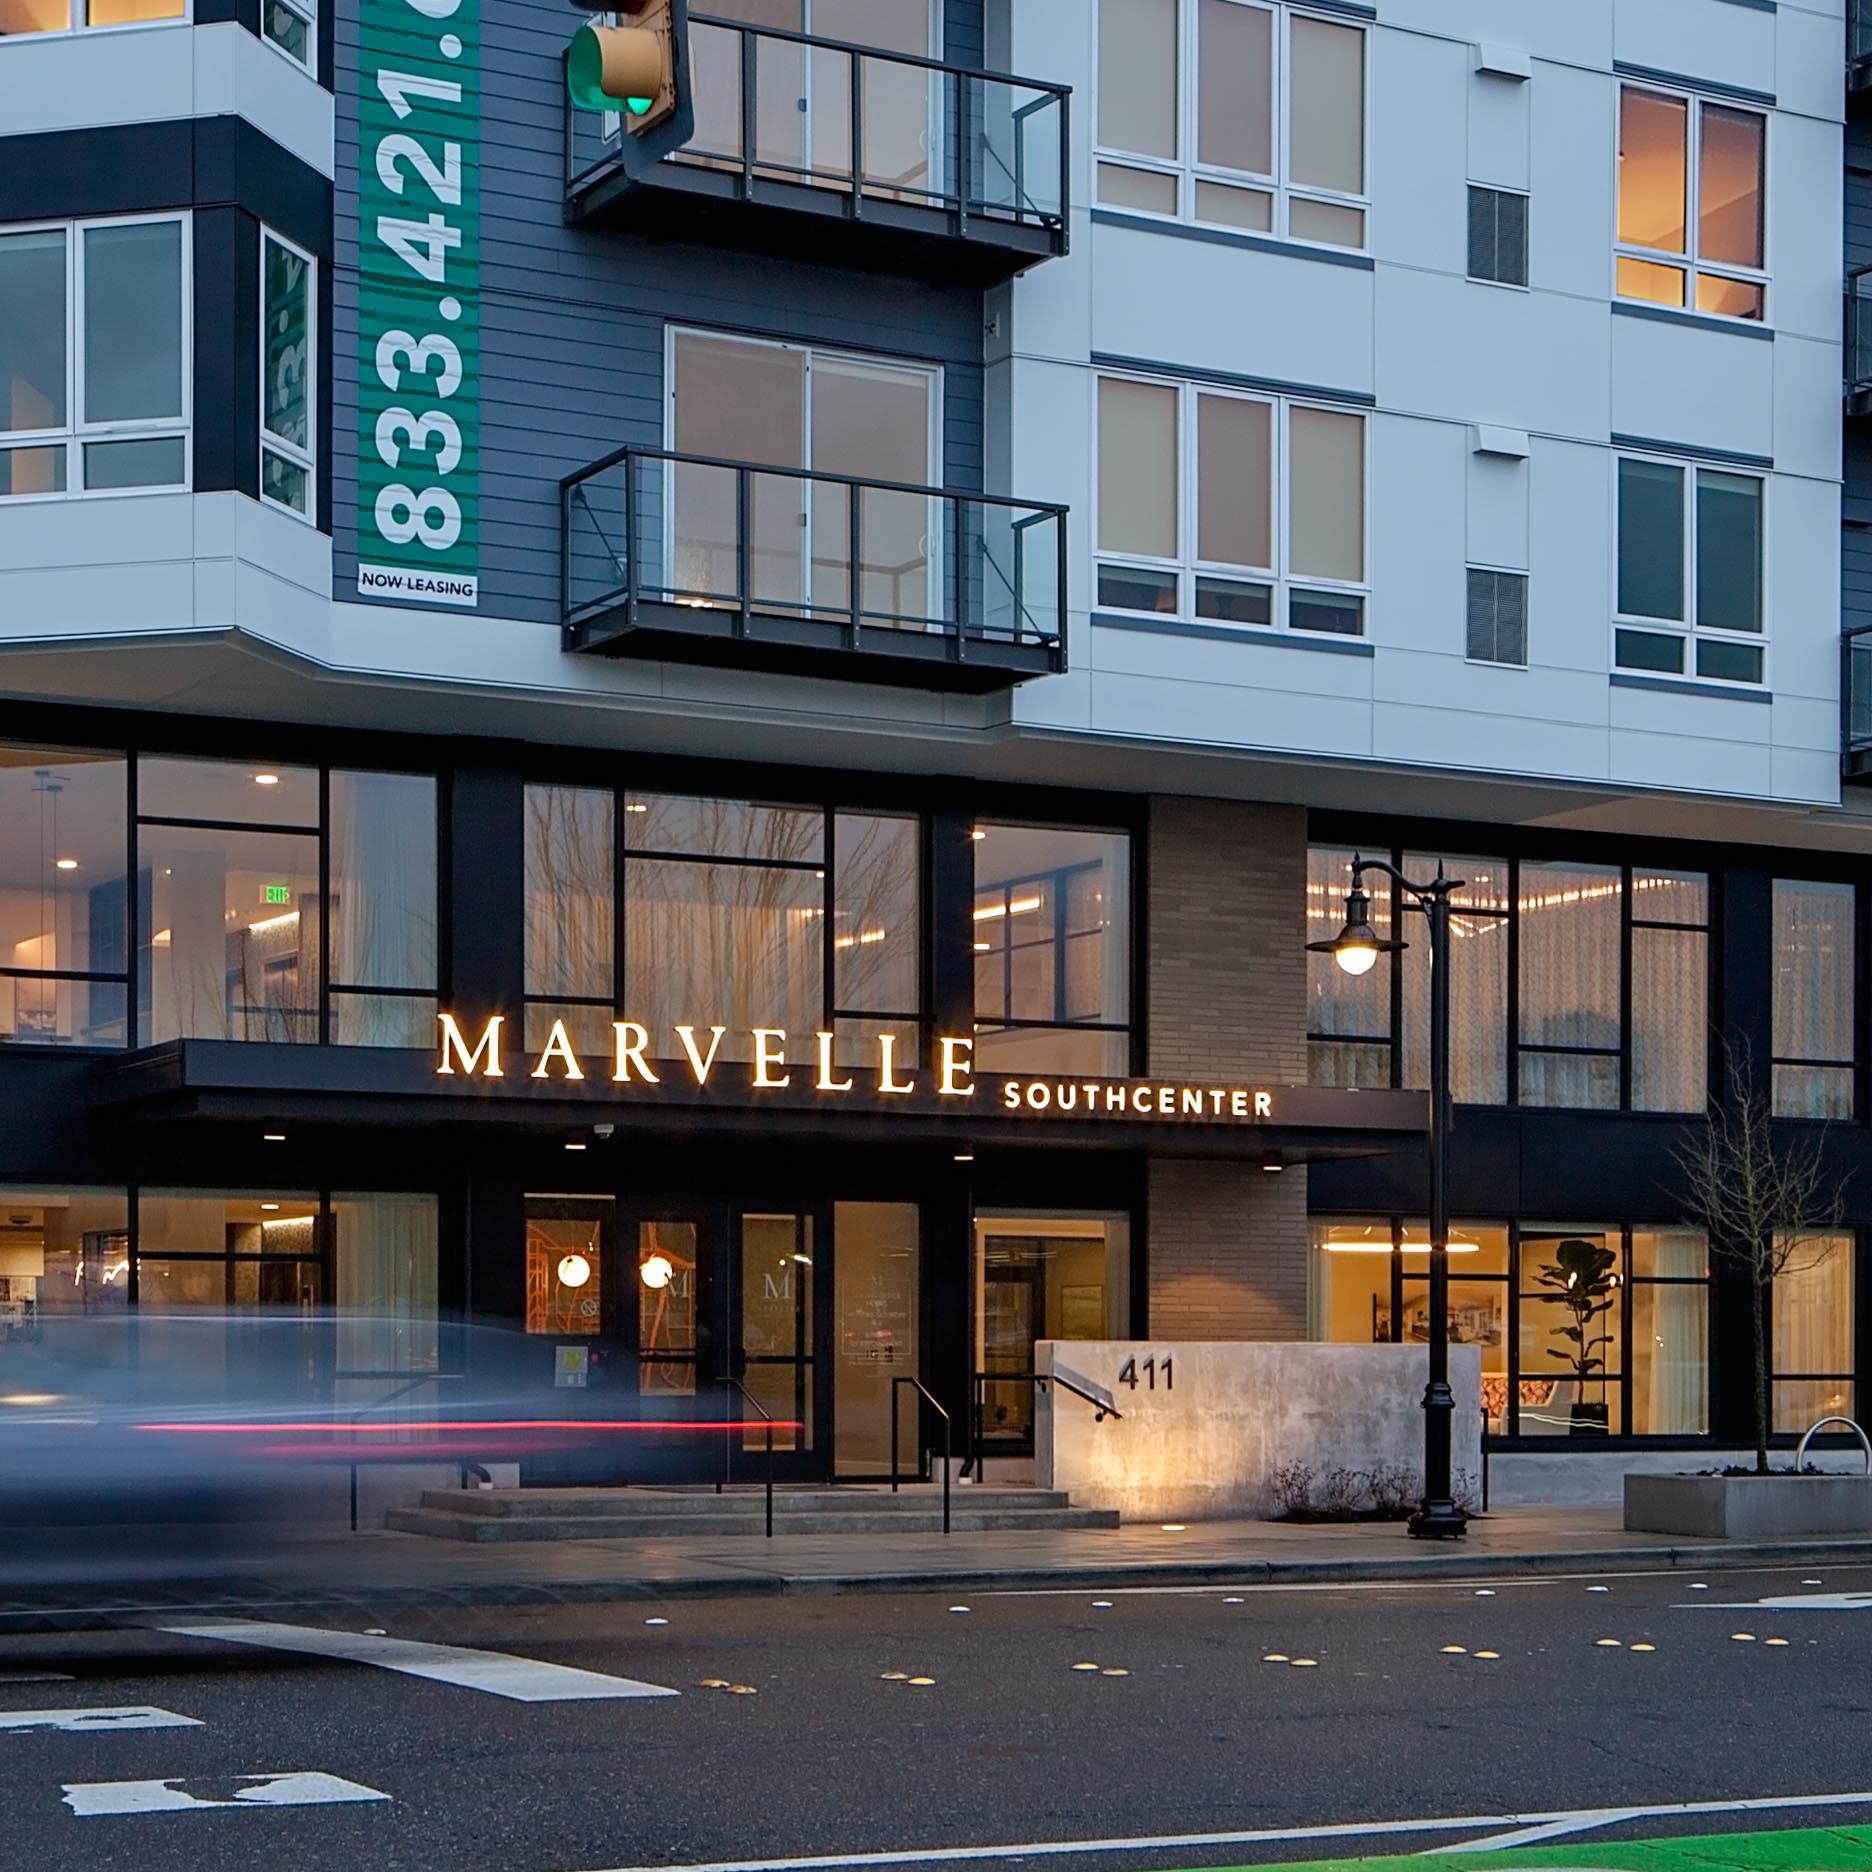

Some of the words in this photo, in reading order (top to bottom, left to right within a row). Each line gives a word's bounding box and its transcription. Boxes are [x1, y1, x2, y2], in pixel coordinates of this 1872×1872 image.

[361, 571, 403, 590] NOW
[406, 576, 474, 598] LEASING
[436, 1013, 977, 1096] MARVELLE
[1004, 1080, 1274, 1119] SOUTHCENTER
[1119, 1353, 1175, 1391] 411
